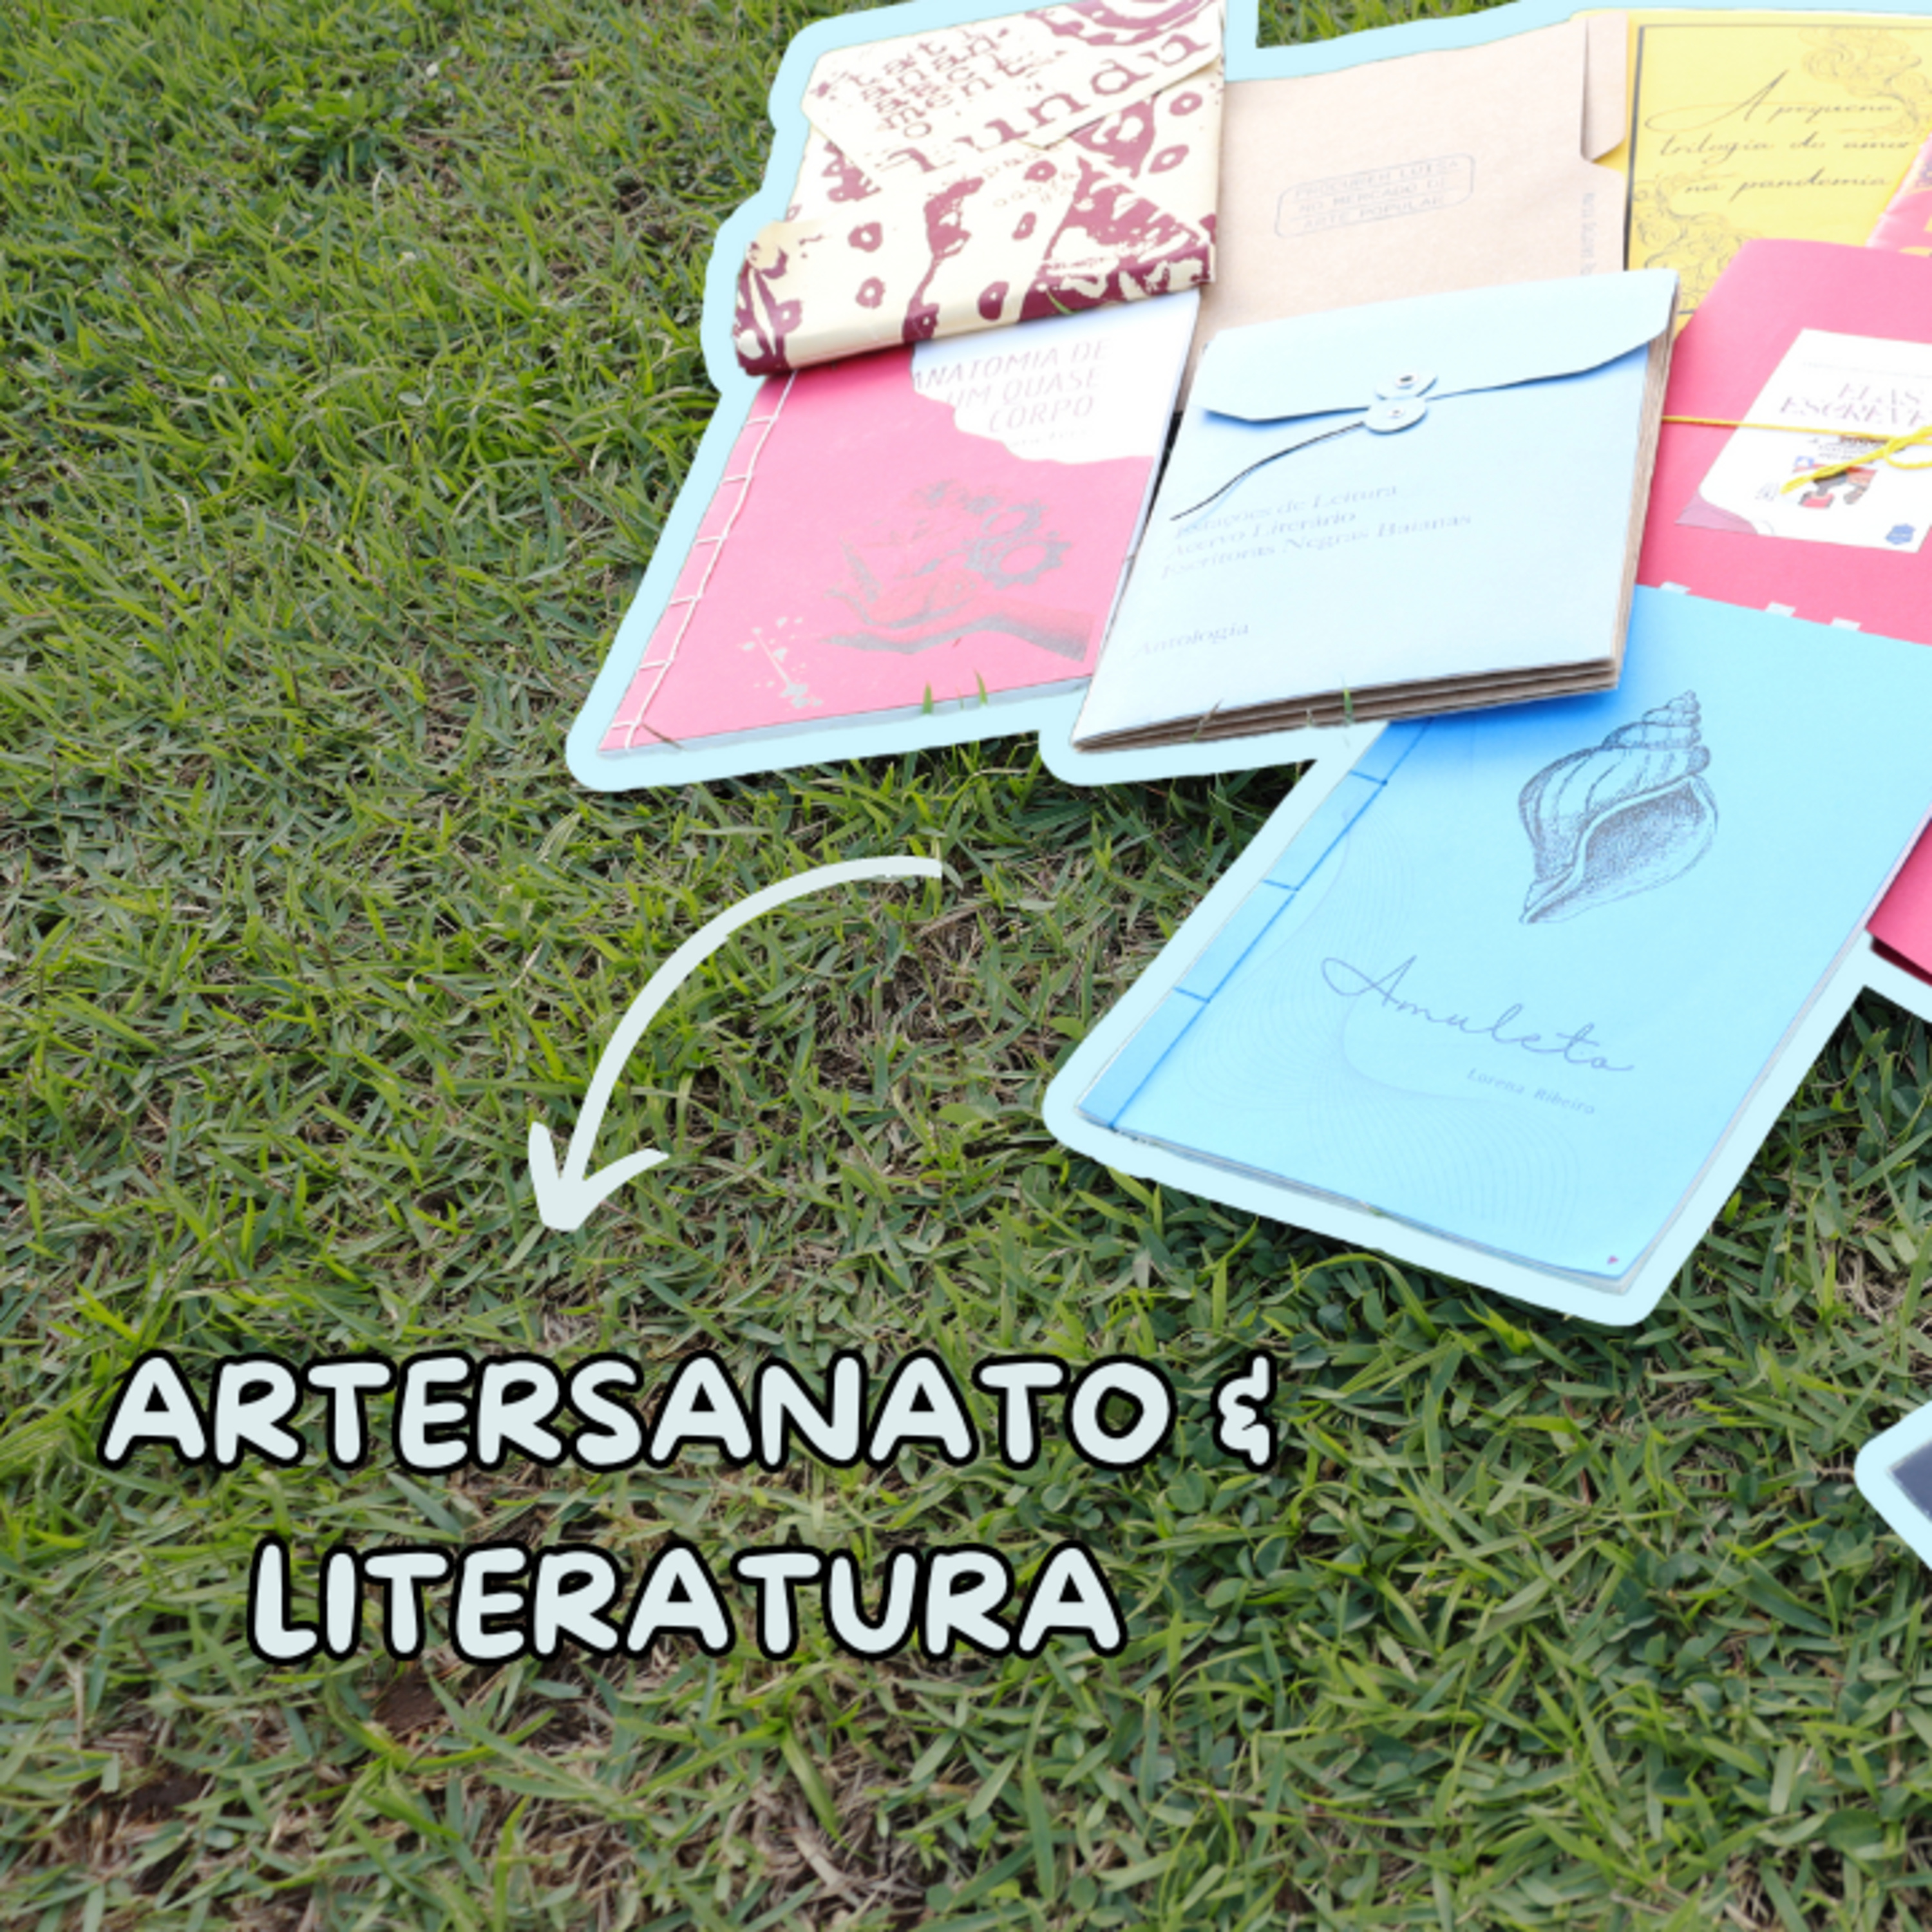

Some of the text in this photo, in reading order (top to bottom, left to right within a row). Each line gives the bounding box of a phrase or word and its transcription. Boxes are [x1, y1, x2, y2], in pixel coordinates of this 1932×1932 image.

[1660, 133, 1775, 165] trilogia
[1729, 167, 1891, 203] pandemia
[1359, 195, 1445, 218] POPULAR
[1072, 339, 1112, 361] DE
[947, 368, 1101, 408] UM QUASE
[989, 396, 1094, 432] CORPO
[1276, 498, 1306, 515] de
[1312, 485, 1397, 509] Leitura
[1161, 514, 1472, 579] Escritoras Negras Baianas
[1166, 531, 1246, 560] Acervo
[1132, 621, 1249, 658] Antologia
[1321, 954, 1634, 1071] Amuleto
[1466, 1068, 1596, 1115] Lorena Ribeiro
